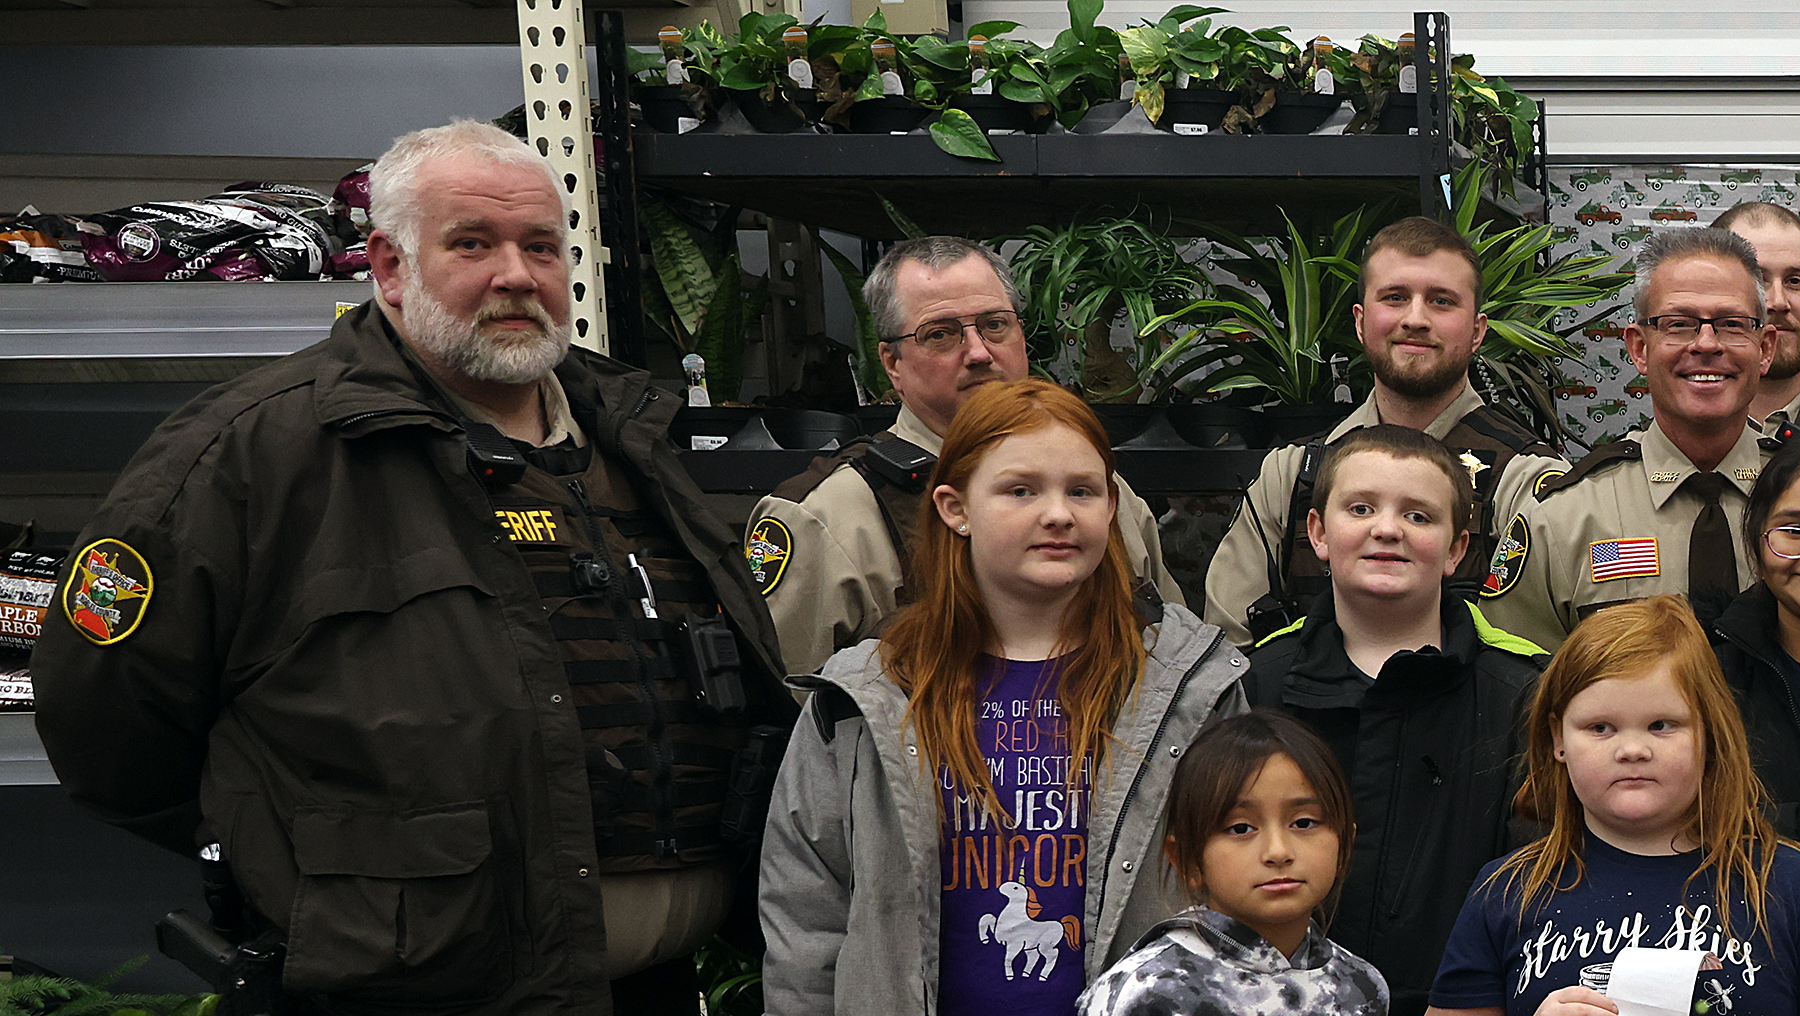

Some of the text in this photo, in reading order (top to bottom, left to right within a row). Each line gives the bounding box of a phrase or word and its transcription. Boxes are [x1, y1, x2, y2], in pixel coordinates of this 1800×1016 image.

[59, 267, 100, 280] PREMIU
[494, 510, 557, 542] ERIFF
[0, 606, 38, 623] APLE
[981, 699, 1062, 719] 2% OF THE
[995, 719, 1039, 752] RED
[954, 789, 1092, 832] MAJESTI
[1513, 904, 1762, 999] Starry Skies
